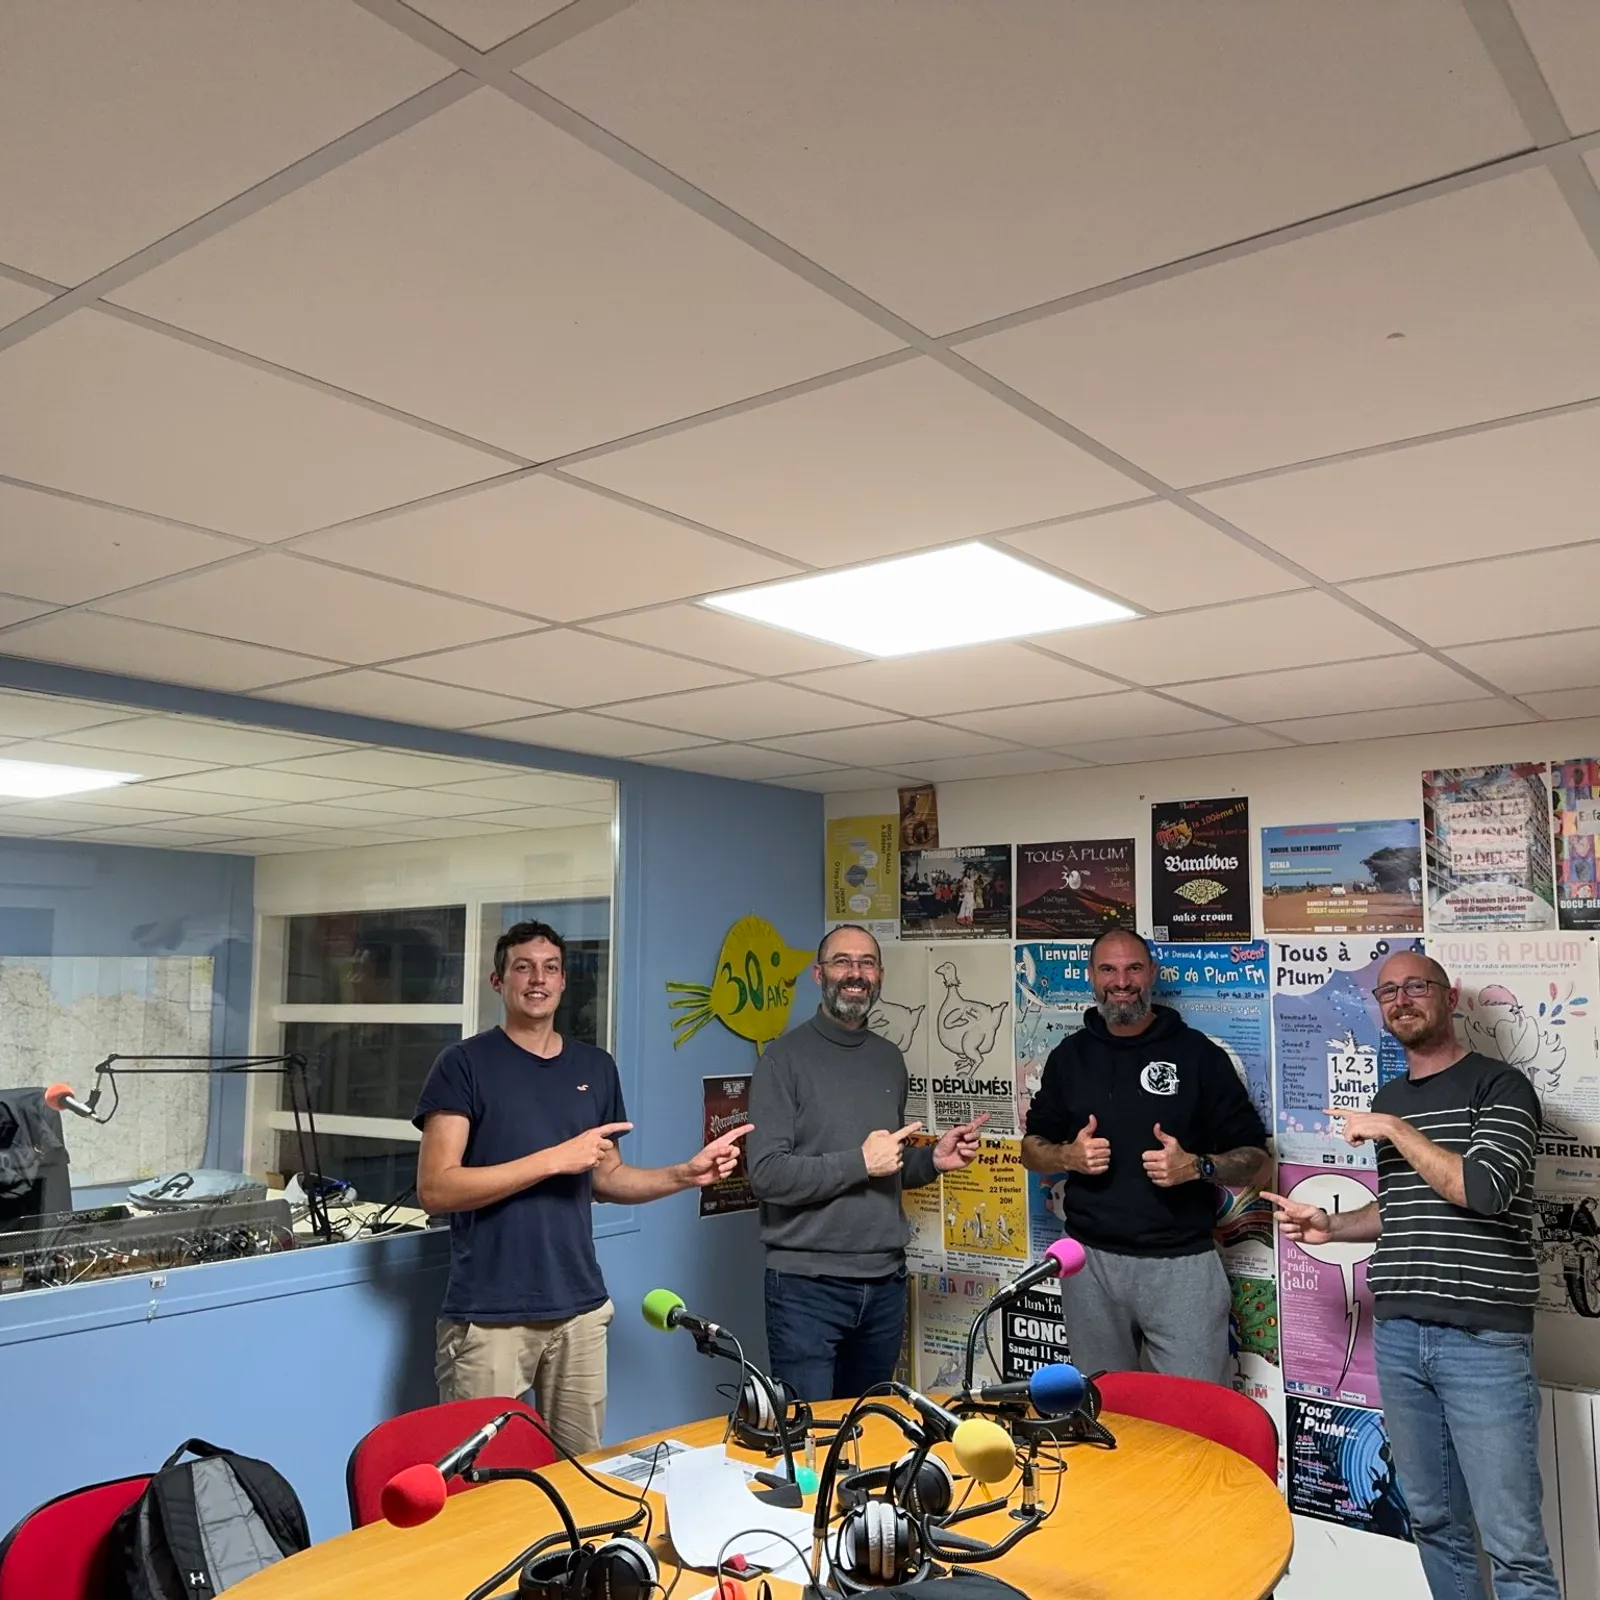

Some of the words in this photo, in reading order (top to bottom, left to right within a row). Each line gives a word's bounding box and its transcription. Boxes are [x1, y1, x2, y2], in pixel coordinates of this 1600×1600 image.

[1024, 850, 1065, 863] TOUS
[1081, 846, 1128, 861] PLUM'
[1164, 854, 1238, 872] Barabbas
[1200, 912, 1233, 923] crown
[1040, 944, 1091, 960] l'envolé
[1278, 944, 1328, 963] Tous
[1338, 941, 1351, 962] à
[1436, 942, 1488, 962] TOUS
[1064, 962, 1080, 979] de
[1160, 966, 1180, 983] ans
[1184, 966, 1199, 983] de
[1276, 966, 1332, 987] Plum'
[720, 950, 764, 1016] 30
[767, 984, 789, 1012] ANS
[1304, 1040, 1310, 1048] 2
[1364, 1058, 1374, 1074] 3
[908, 1074, 928, 1092] ÉS!
[932, 1074, 1012, 1096] DÉPLUMÉS!
[934, 1100, 960, 1109] SAMEDI
[962, 1100, 970, 1110] 15
[1332, 1095, 1360, 1108] 2011
[935, 1108, 971, 1116] SEPTEMBRE
[978, 1154, 999, 1164] Fest
[994, 1175, 1015, 1183] Sérent
[1000, 1186, 1022, 1194] Février
[56, 1210, 109, 1222] behringer
[1286, 1248, 1297, 1260] 10
[1288, 1261, 1315, 1273] radio
[1281, 1271, 1319, 1291] Galo!
[1014, 1316, 1068, 1345] CONC
[1008, 1342, 1038, 1358] Samedi
[1040, 1346, 1051, 1360] 11
[1054, 1351, 1072, 1364] Sept
[1013, 1357, 1049, 1373] PLU
[1298, 1402, 1332, 1420] TOUS
[1304, 1416, 1350, 1438] PLUM'
